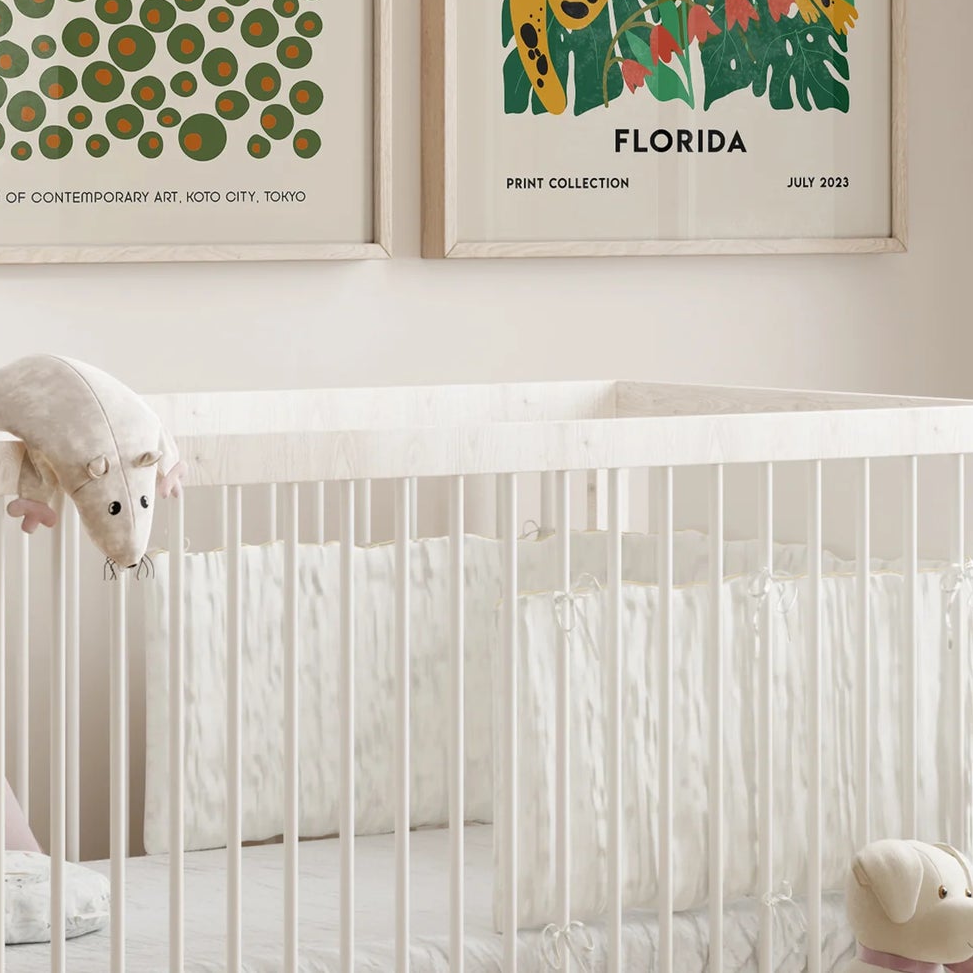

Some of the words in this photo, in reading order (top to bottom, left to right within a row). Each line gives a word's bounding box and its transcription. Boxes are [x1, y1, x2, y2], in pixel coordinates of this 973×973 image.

[615, 129, 747, 152] FLORIDA
[507, 177, 544, 189] PRINT
[549, 177, 630, 189] COLLECTION
[787, 176, 815, 188] JULY
[820, 176, 850, 188] 2023
[6, 191, 26, 203] OF
[31, 191, 150, 203] CONTEMPORARY
[153, 191, 182, 204] ART,
[187, 191, 221, 203] KOTO
[226, 190, 259, 203] CITY,
[264, 190, 307, 202] TOKYO
